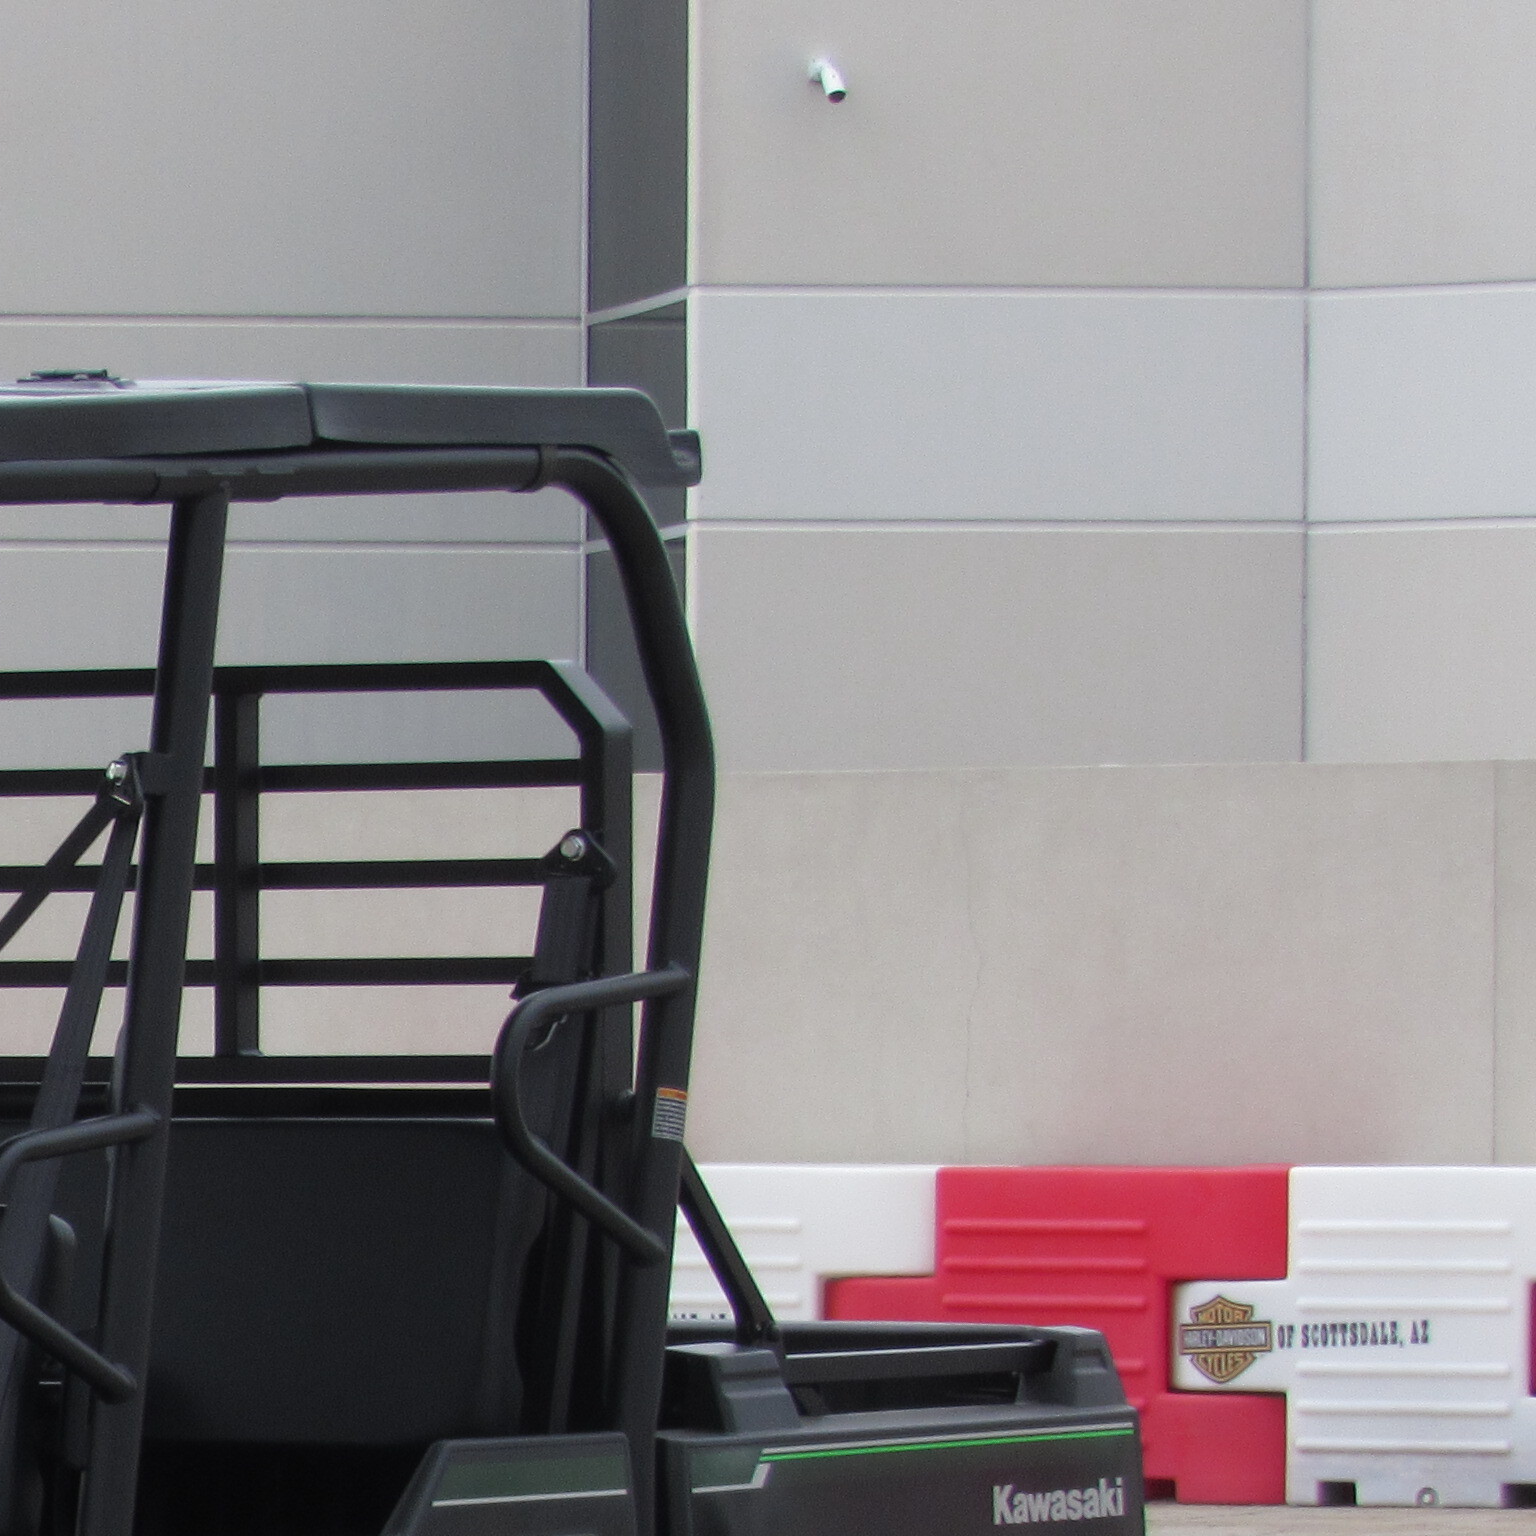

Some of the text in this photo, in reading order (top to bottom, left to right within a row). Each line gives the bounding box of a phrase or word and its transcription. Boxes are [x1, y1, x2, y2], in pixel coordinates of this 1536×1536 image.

[1278, 1324, 1294, 1348] OF
[1411, 1320, 1429, 1344] AZ
[992, 1477, 1125, 1525] Kawasaki
